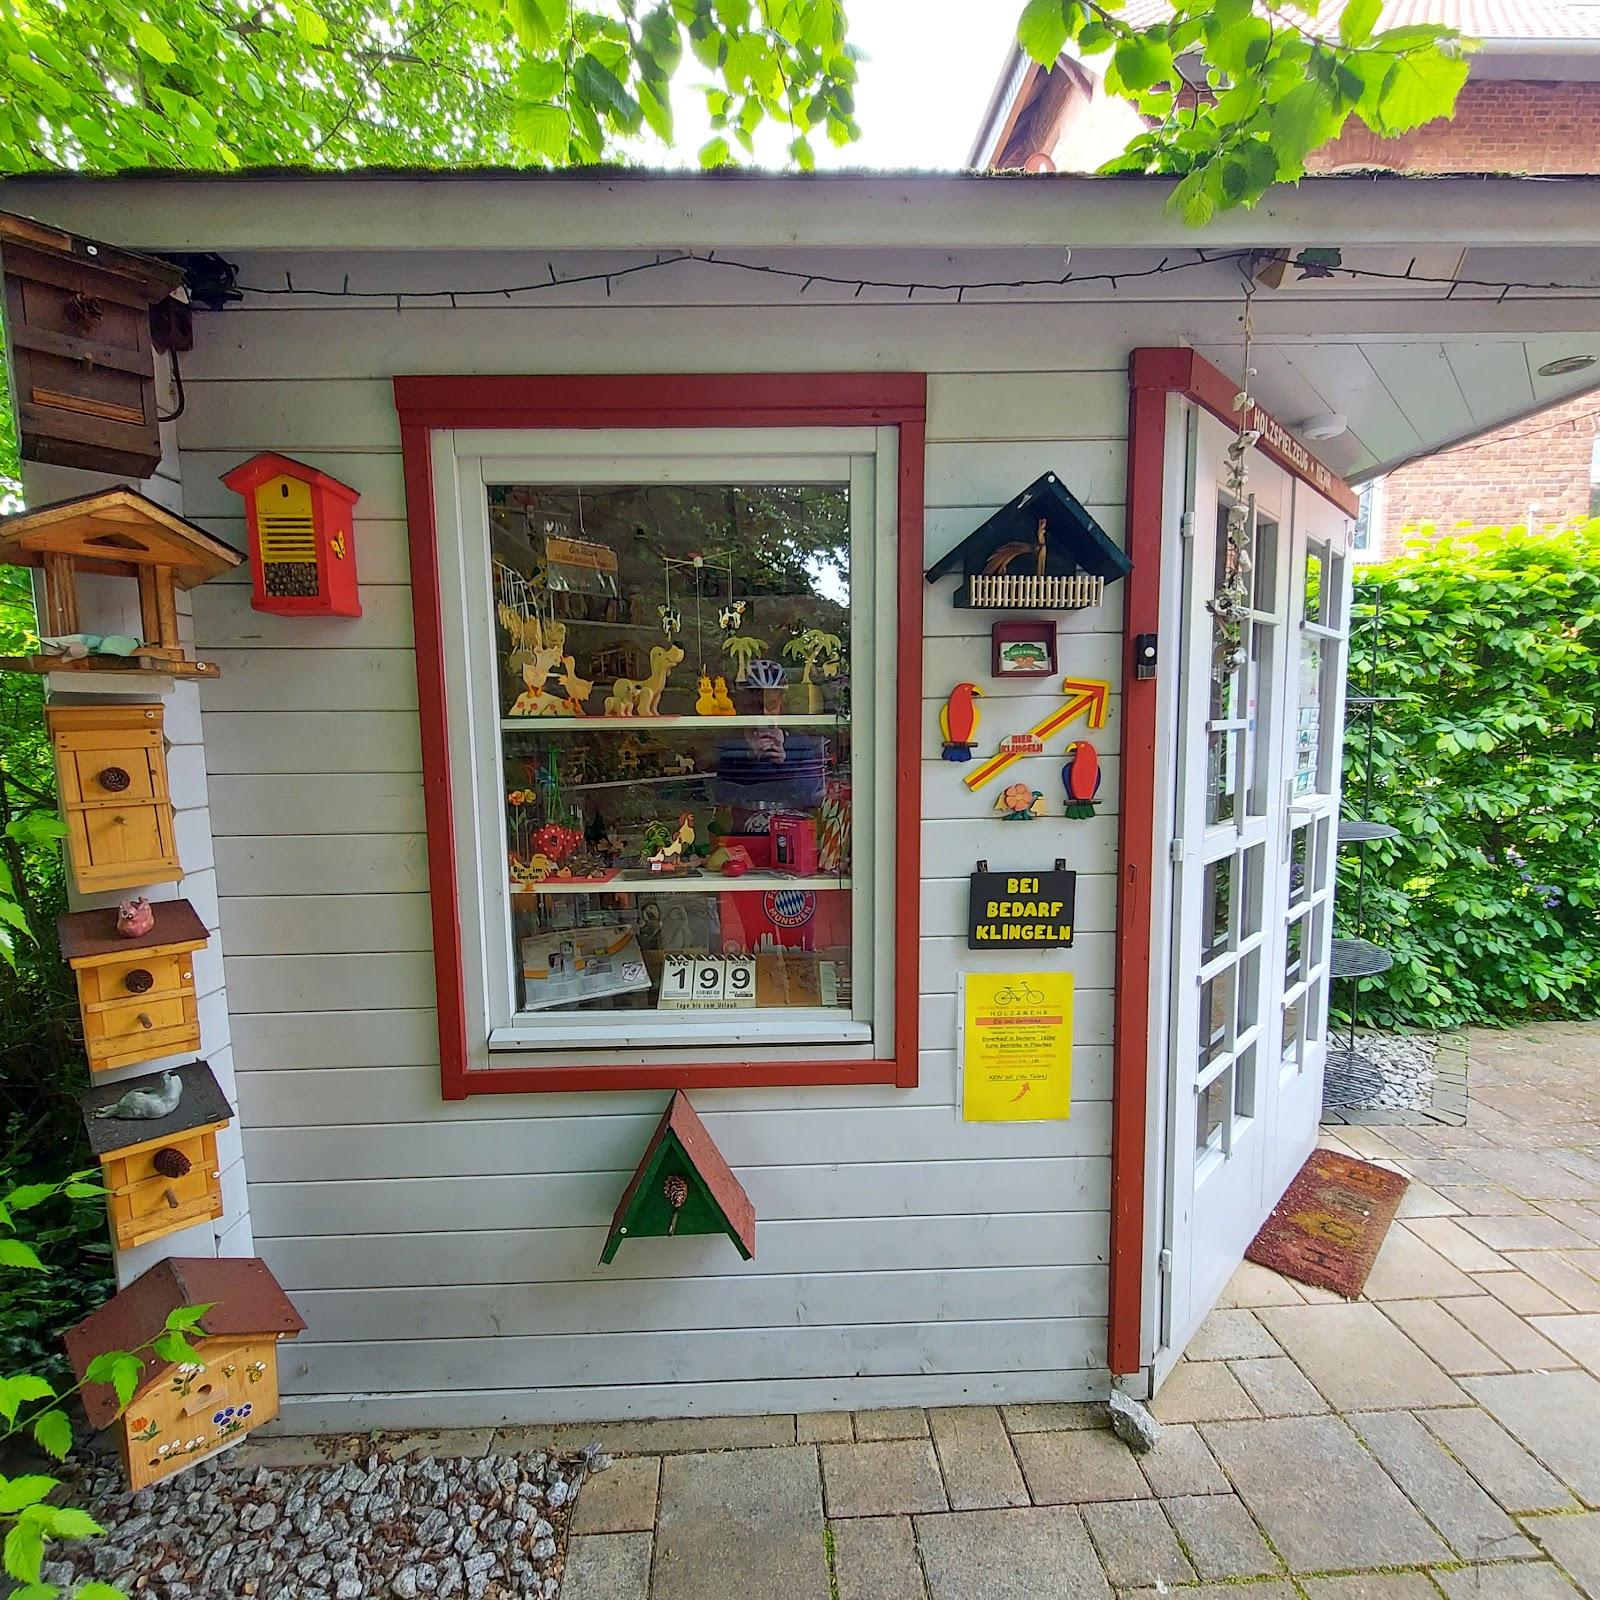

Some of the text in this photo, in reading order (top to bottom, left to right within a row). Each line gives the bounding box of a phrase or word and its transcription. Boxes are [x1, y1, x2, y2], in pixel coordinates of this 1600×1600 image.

[1254, 407, 1309, 472] HOLZSPIELZEUG
[1011, 735, 1032, 743] HIER
[1001, 743, 1043, 752] KLINGELN
[1007, 878, 1039, 893] BEI
[986, 902, 1064, 918] BEDARF
[976, 924, 1071, 940] KLINGELN
